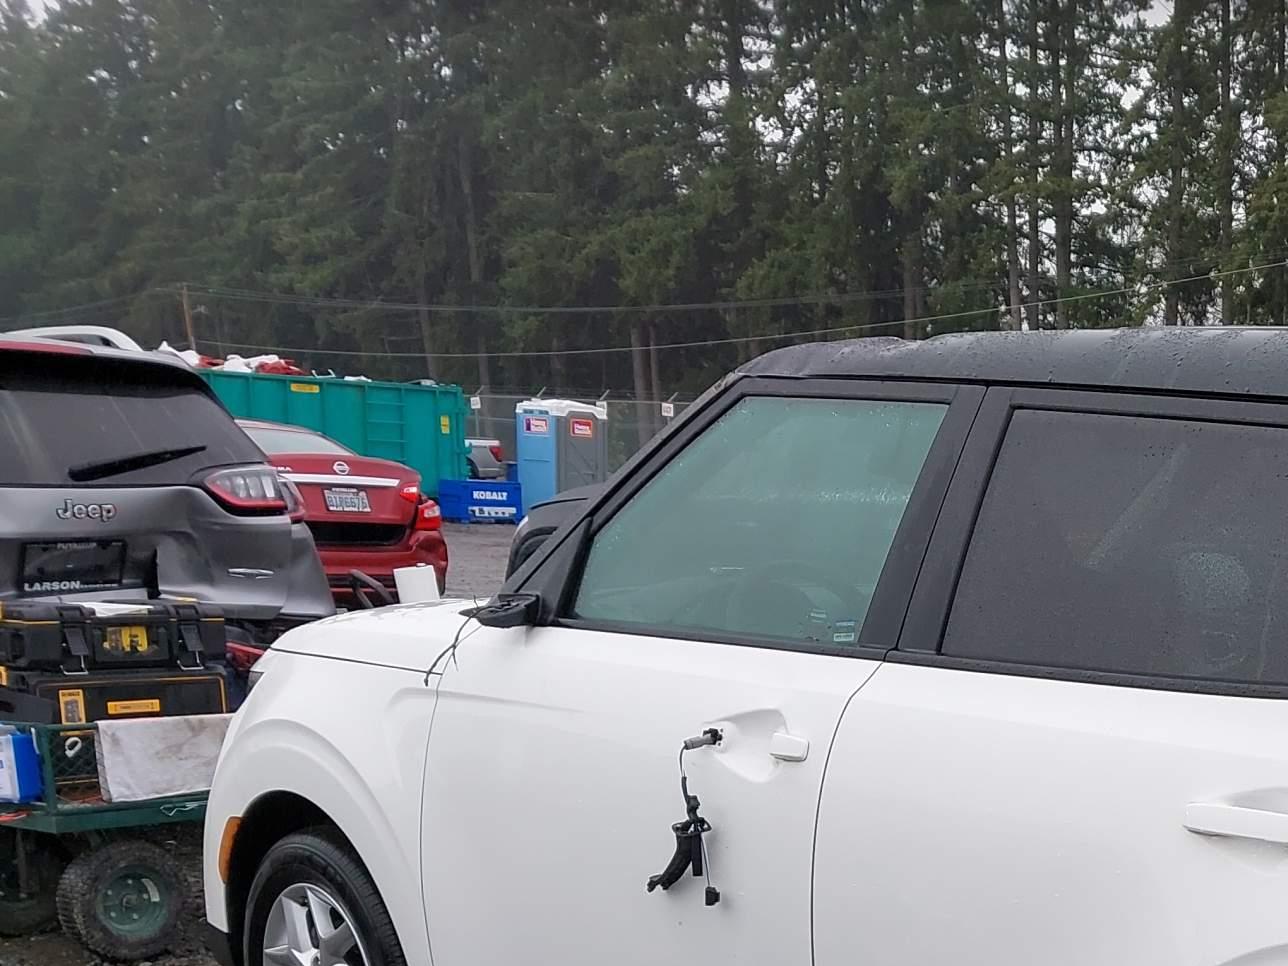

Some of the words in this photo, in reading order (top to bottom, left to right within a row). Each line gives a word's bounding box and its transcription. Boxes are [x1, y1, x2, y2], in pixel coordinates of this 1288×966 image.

[472, 490, 508, 500] KOBALT
[56, 498, 117, 522] Jeep
[24, 581, 80, 591] LARSON
